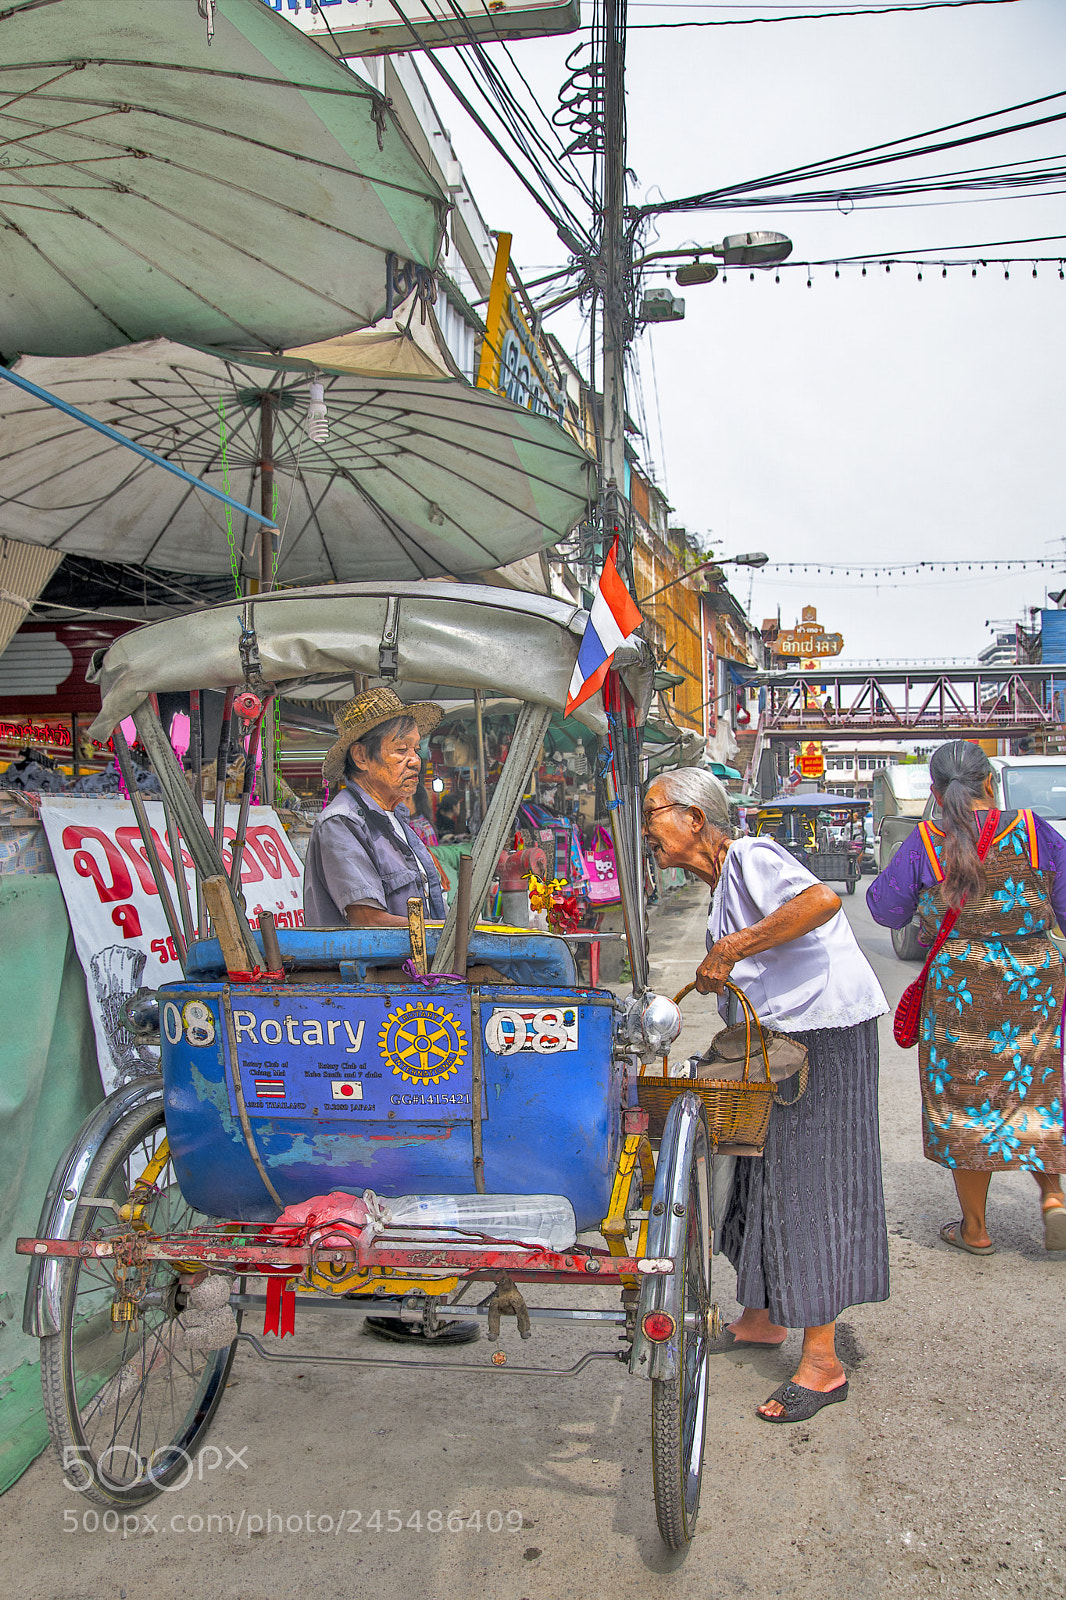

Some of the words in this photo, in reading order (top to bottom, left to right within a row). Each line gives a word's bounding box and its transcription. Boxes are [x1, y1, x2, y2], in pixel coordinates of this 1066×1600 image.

[401, 1009, 440, 1022] ROTARY
[162, 1000, 216, 1047] 08
[233, 1010, 366, 1053] Rotary
[485, 1009, 568, 1056] 08
[317, 1062, 339, 1071] Rotary
[341, 1062, 357, 1070] Club
[393, 1055, 457, 1078] INTERNATIONAL
[265, 1101, 307, 1110] THAILAND
[389, 1093, 471, 1105] GG#1415421
[350, 1103, 376, 1112] JAPAN
